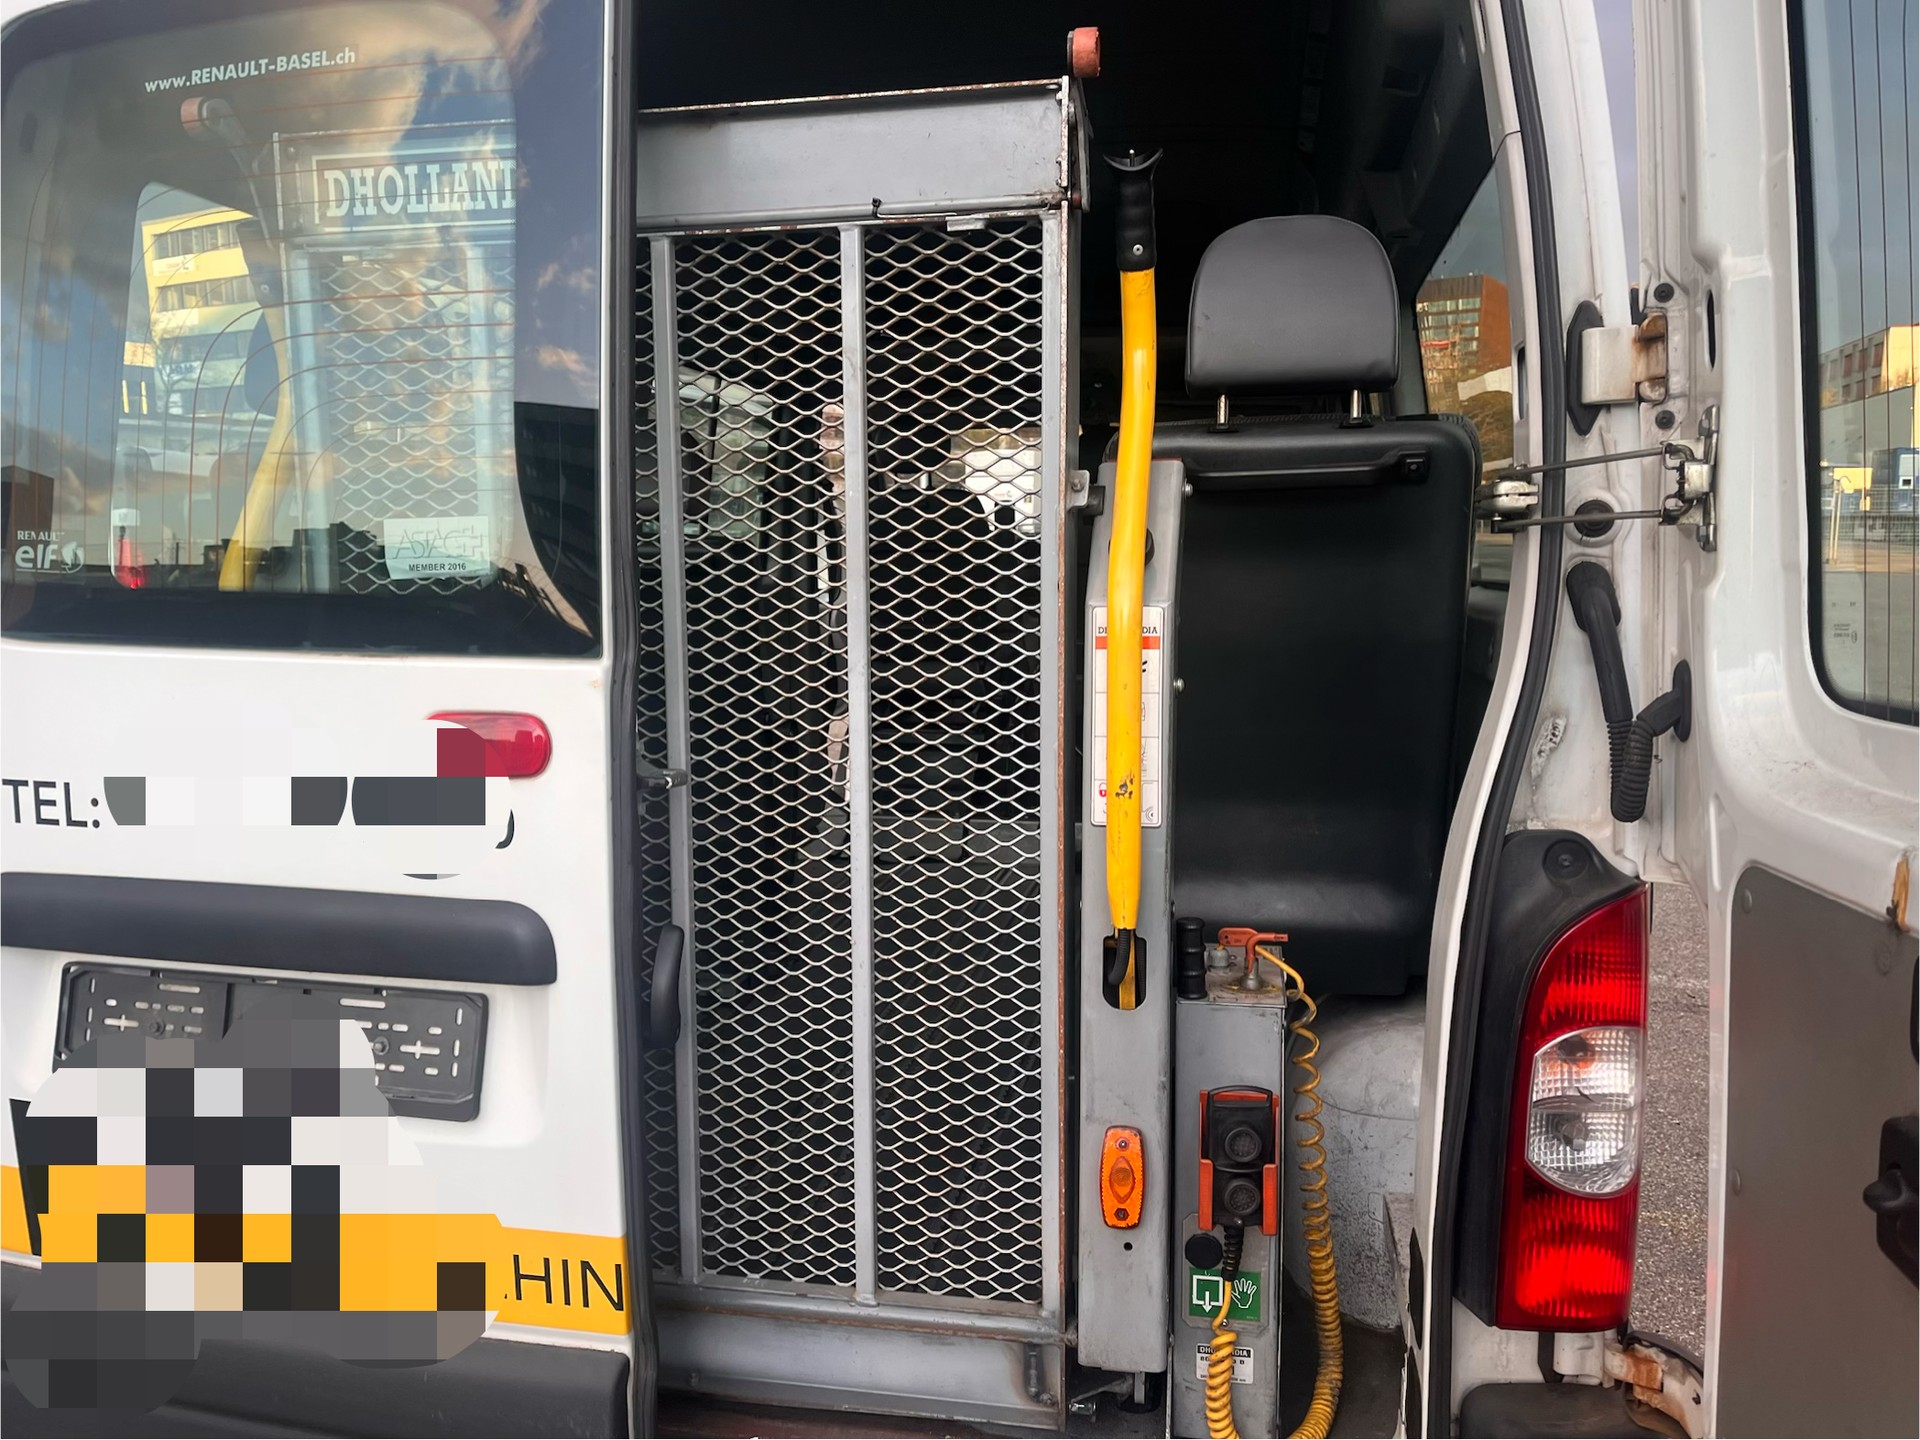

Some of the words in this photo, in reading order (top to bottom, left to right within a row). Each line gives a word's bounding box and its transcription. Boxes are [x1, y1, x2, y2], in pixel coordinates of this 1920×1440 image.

[144, 47, 356, 93] www.RENAULT-BASEL.ch
[408, 563, 445, 571] MEMBER
[2, 778, 100, 829] TEL:
[504, 1254, 624, 1311] HIN
